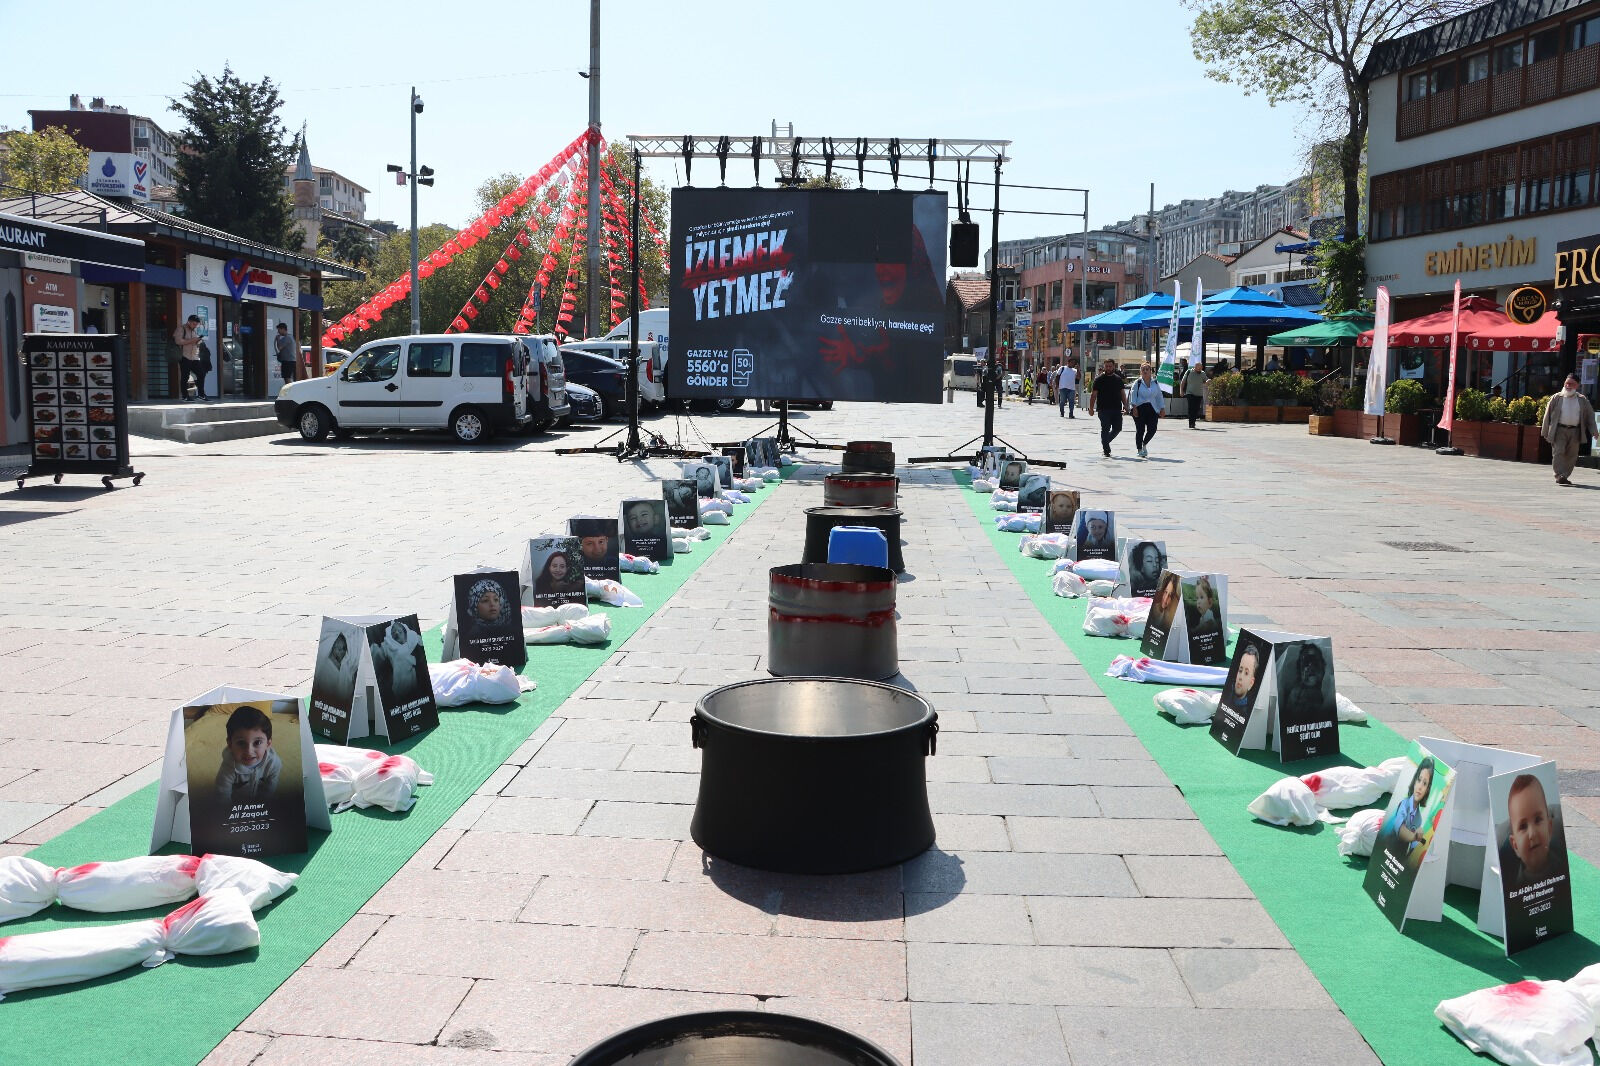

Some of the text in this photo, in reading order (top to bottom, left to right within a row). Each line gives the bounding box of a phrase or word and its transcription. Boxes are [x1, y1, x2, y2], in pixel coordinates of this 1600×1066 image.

[0, 225, 47, 248] AURANT
[685, 229, 789, 277] İZLEMEK
[1425, 234, 1537, 277] EMİNEVİM
[45, 282, 58, 292] ATM
[693, 269, 794, 321] YETMEZ
[888, 319, 919, 330] harekete
[919, 322, 935, 335] geç!
[46, 341, 94, 350] KAMPANYA
[687, 349, 729, 358] GAZZE YAZ
[687, 360, 729, 373] 5560'a
[686, 374, 728, 387] GÖNDER
[243, 803, 265, 811] Amer
[230, 823, 270, 833] 2020-2023
